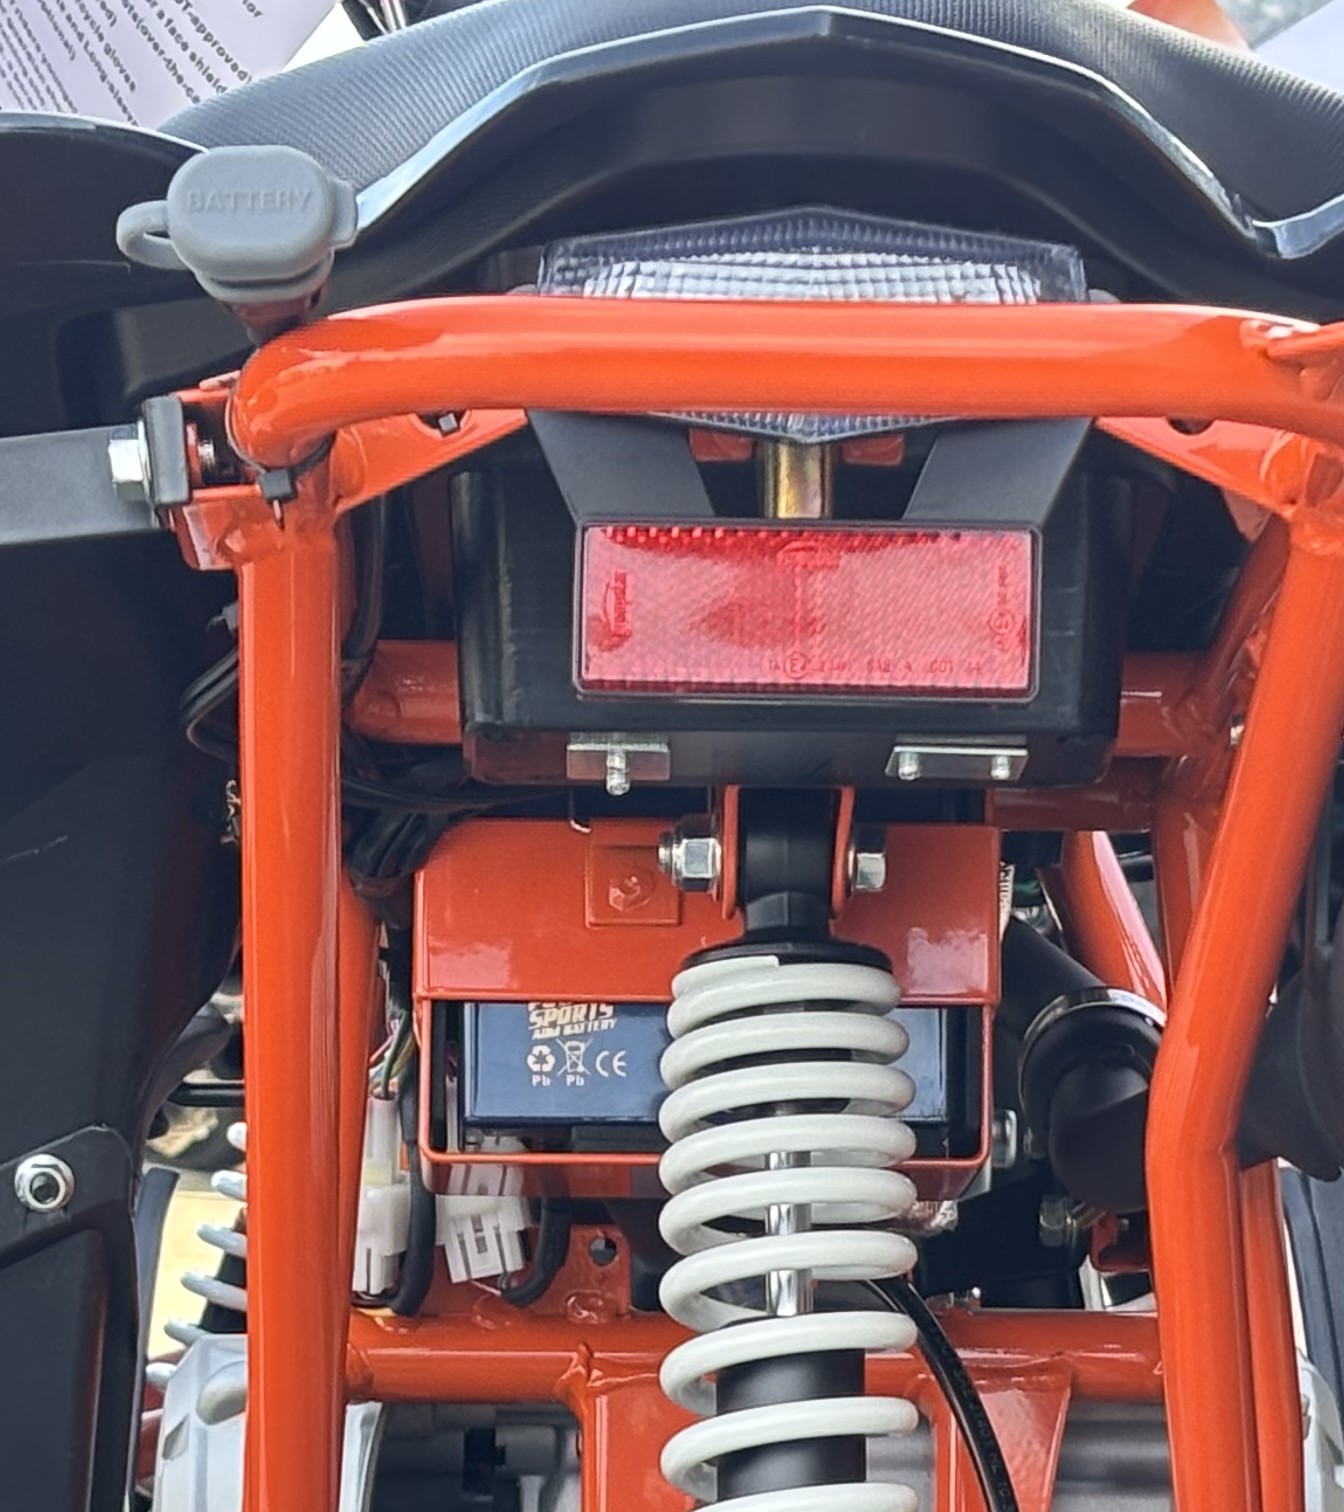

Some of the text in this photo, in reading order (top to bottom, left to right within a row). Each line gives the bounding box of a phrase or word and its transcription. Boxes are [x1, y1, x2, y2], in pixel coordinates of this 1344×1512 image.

[187, 188, 311, 214] BATTERY
[528, 1002, 614, 1031] SPORTS
[562, 1017, 618, 1037] BATTERY
[531, 1074, 552, 1087] Pb
[565, 1074, 586, 1087] Pb
